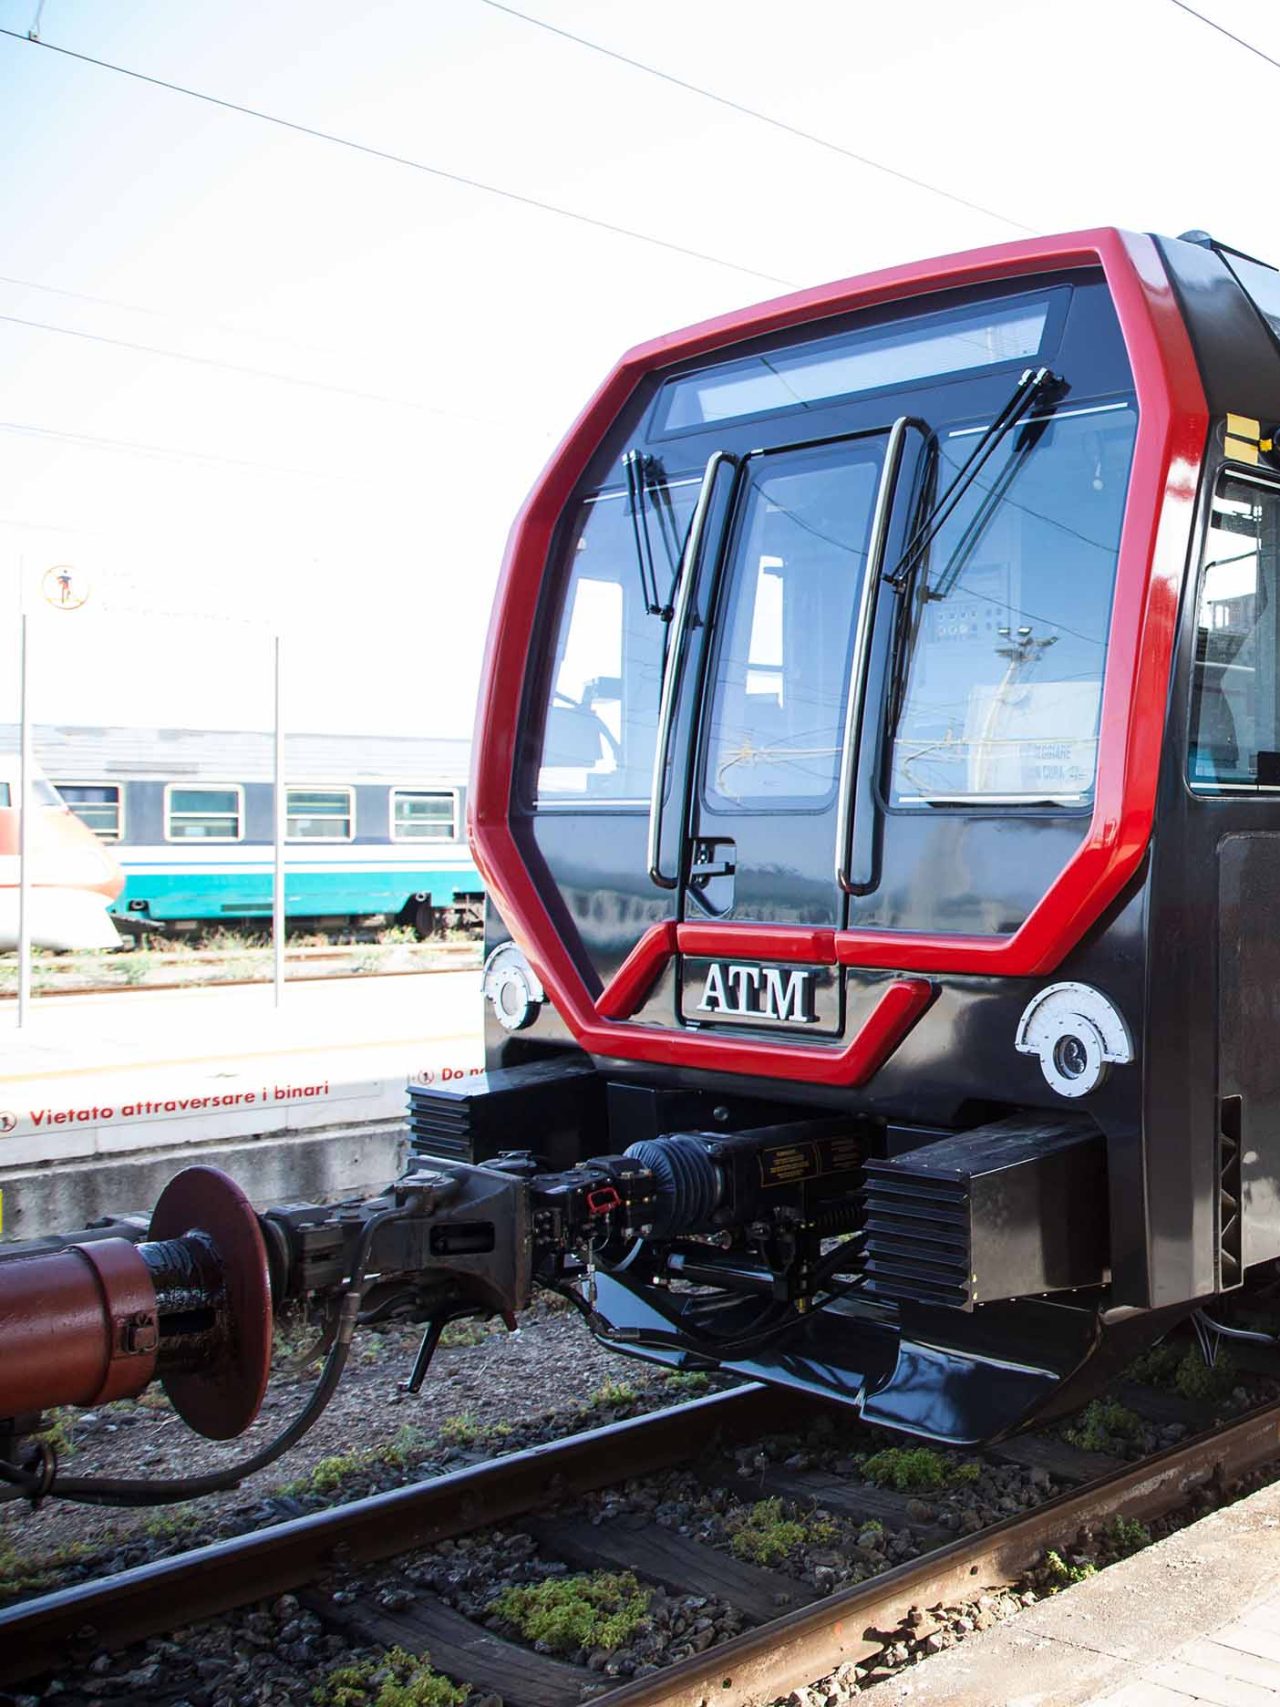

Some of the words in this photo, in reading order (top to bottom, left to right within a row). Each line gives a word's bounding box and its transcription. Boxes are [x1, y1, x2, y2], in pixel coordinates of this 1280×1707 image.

[696, 963, 809, 1022] ATM
[442, 1067, 464, 1081] Do
[30, 1106, 114, 1126] Vietato
[121, 1091, 256, 1117] attraversare
[262, 1086, 267, 1101] i
[274, 1080, 329, 1101] binari
